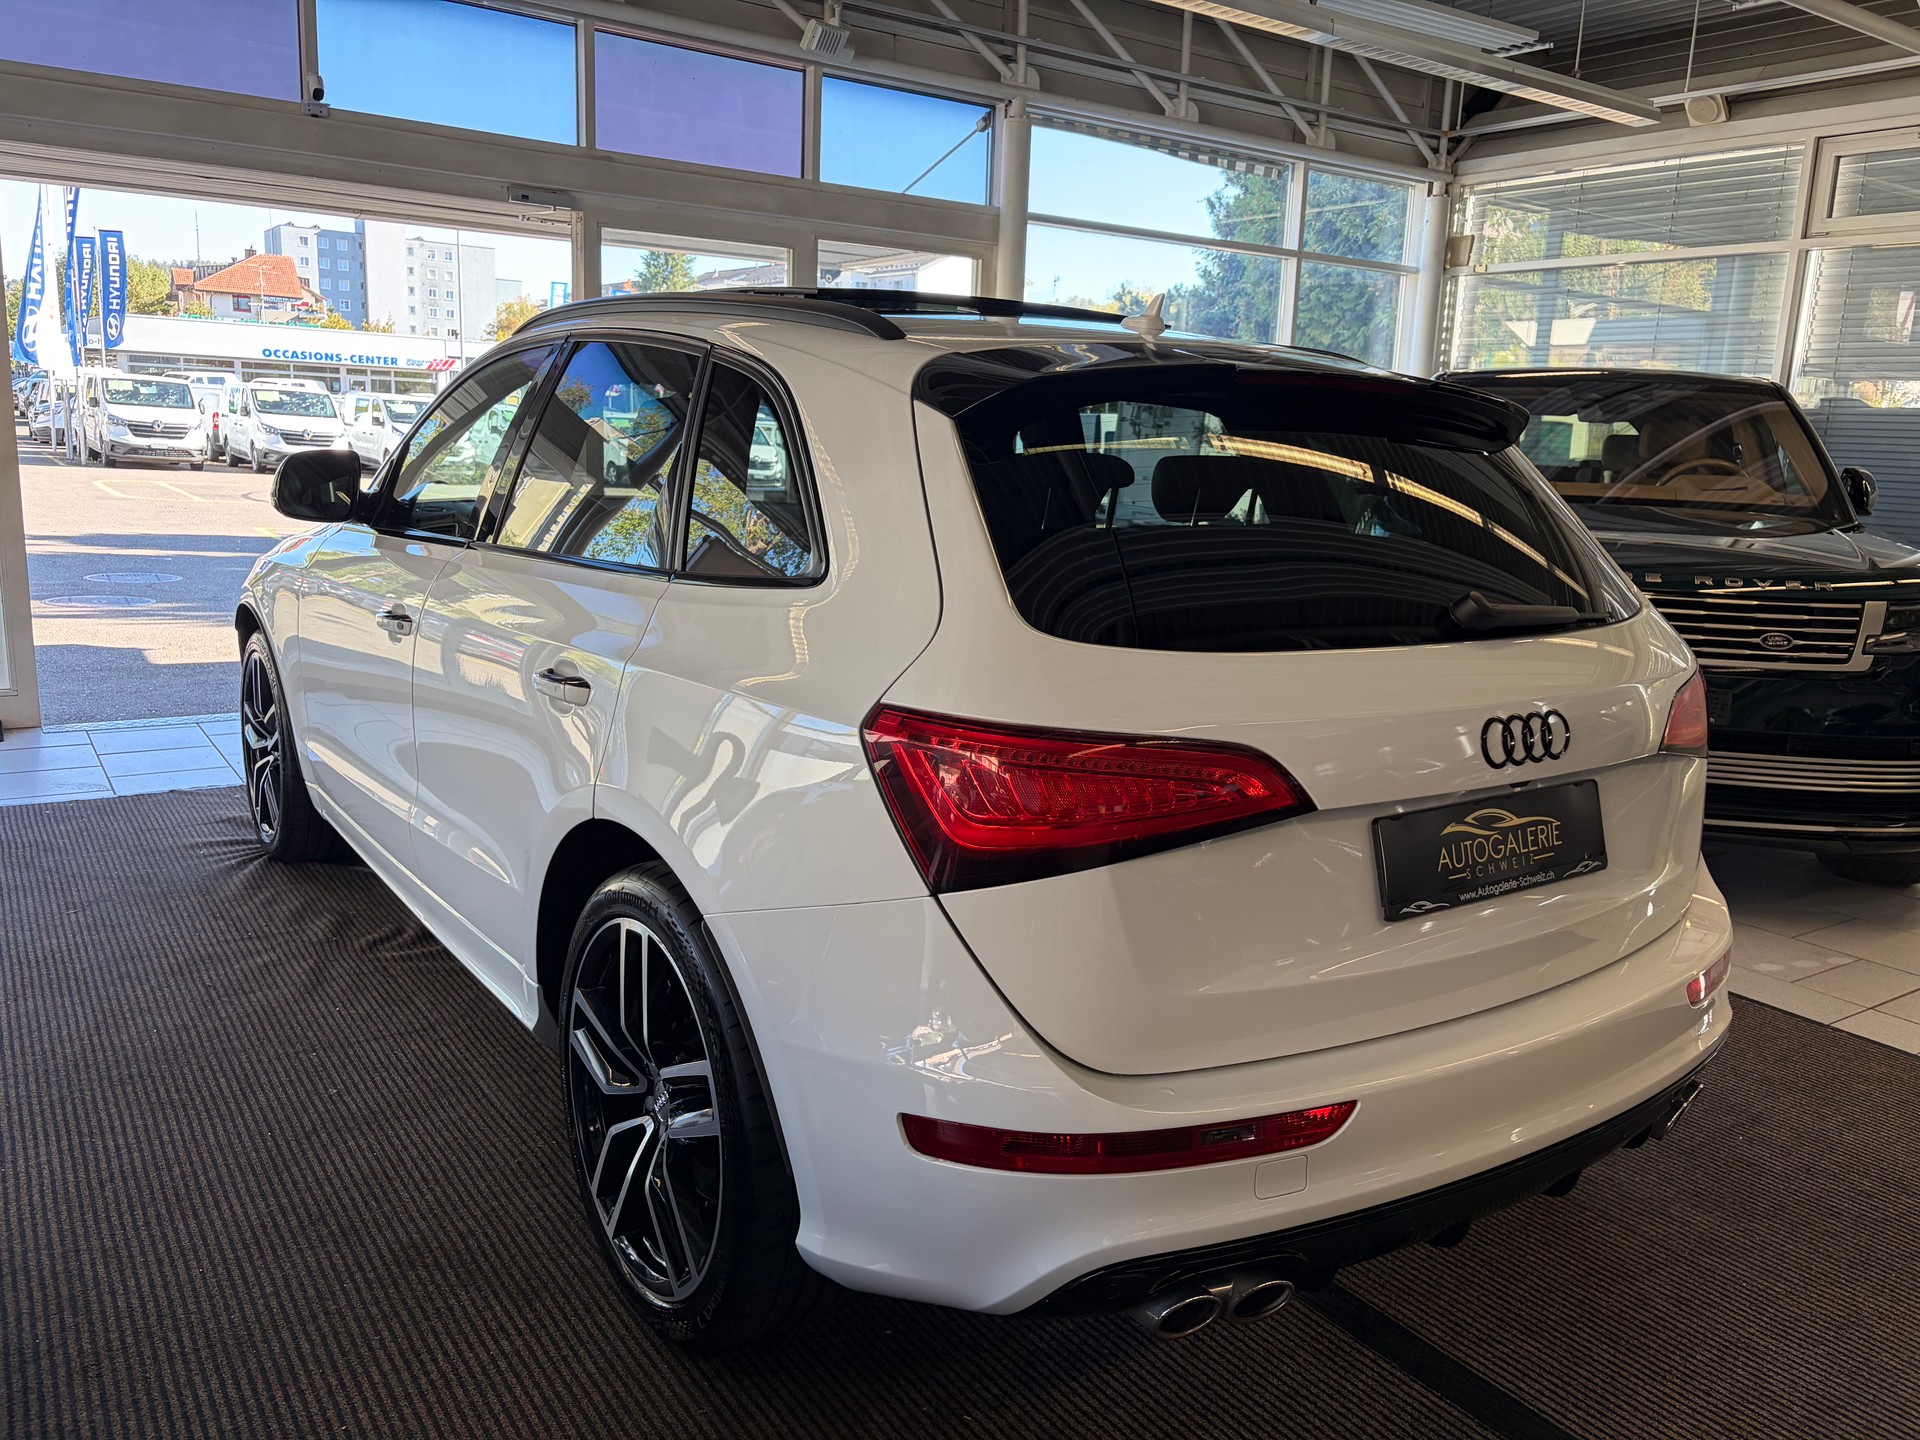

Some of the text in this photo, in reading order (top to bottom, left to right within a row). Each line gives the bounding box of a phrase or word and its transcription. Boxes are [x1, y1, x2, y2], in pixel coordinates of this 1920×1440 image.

[80, 243, 92, 310] HYUNDAI
[106, 236, 121, 310] HYUNDAI
[262, 348, 398, 365] OCCASIONS-CENTER
[1694, 575, 1834, 592] ROVER
[1438, 821, 1562, 872] AUTOGALERIE
[1466, 853, 1535, 880] SCHWEIZ
[1458, 870, 1555, 901] www.Autogalerie-Schweiz.ch
